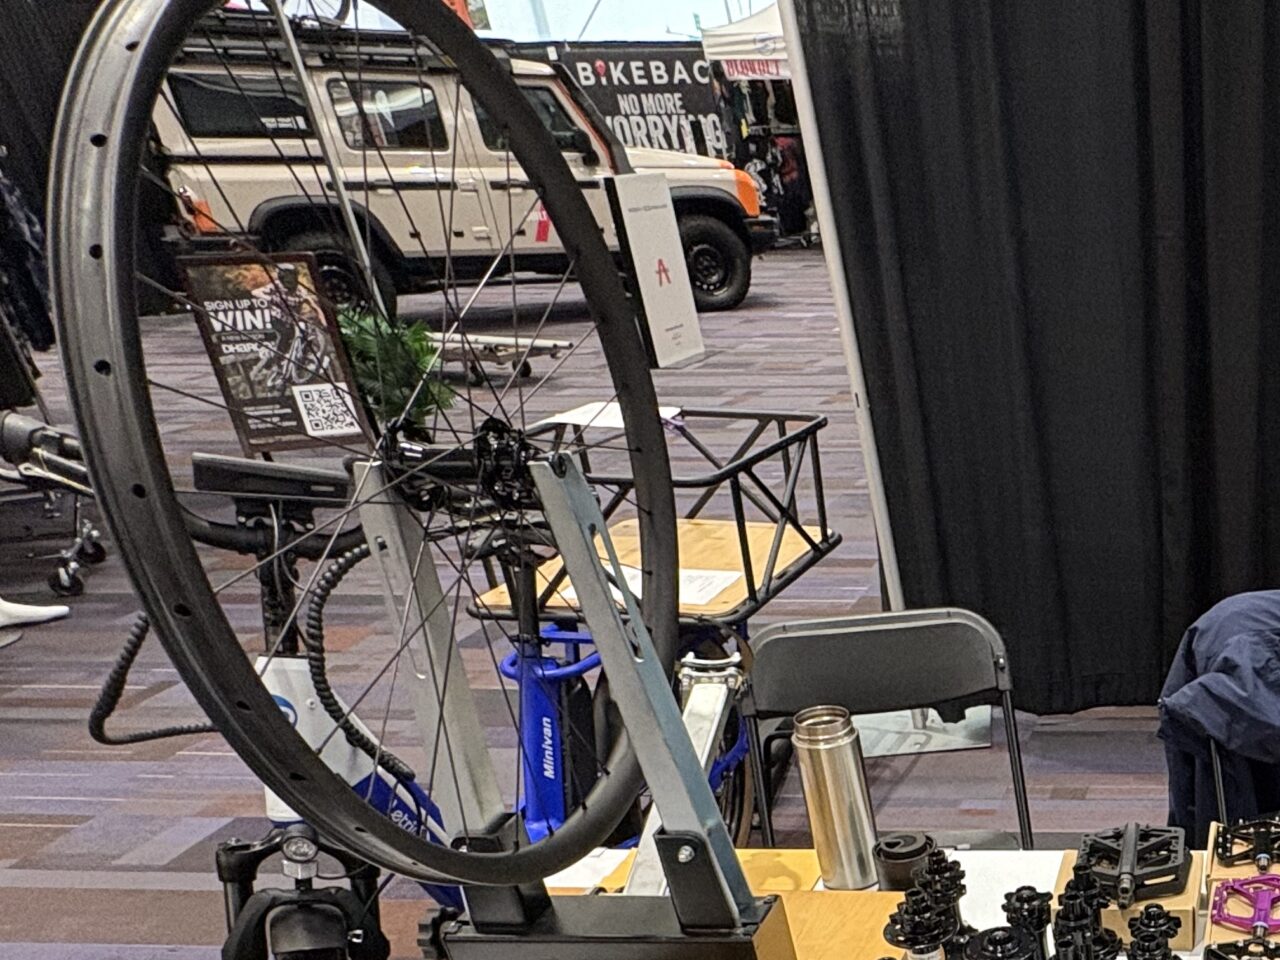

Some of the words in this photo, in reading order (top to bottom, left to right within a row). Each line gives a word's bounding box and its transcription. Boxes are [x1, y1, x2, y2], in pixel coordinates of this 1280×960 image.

[618, 94, 640, 115] NO
[641, 93, 686, 115] MORE
[203, 300, 234, 311] SIGN
[235, 300, 250, 310] UP
[252, 299, 268, 309] TO
[208, 308, 273, 332] WIN!
[541, 716, 555, 779] Minivan
